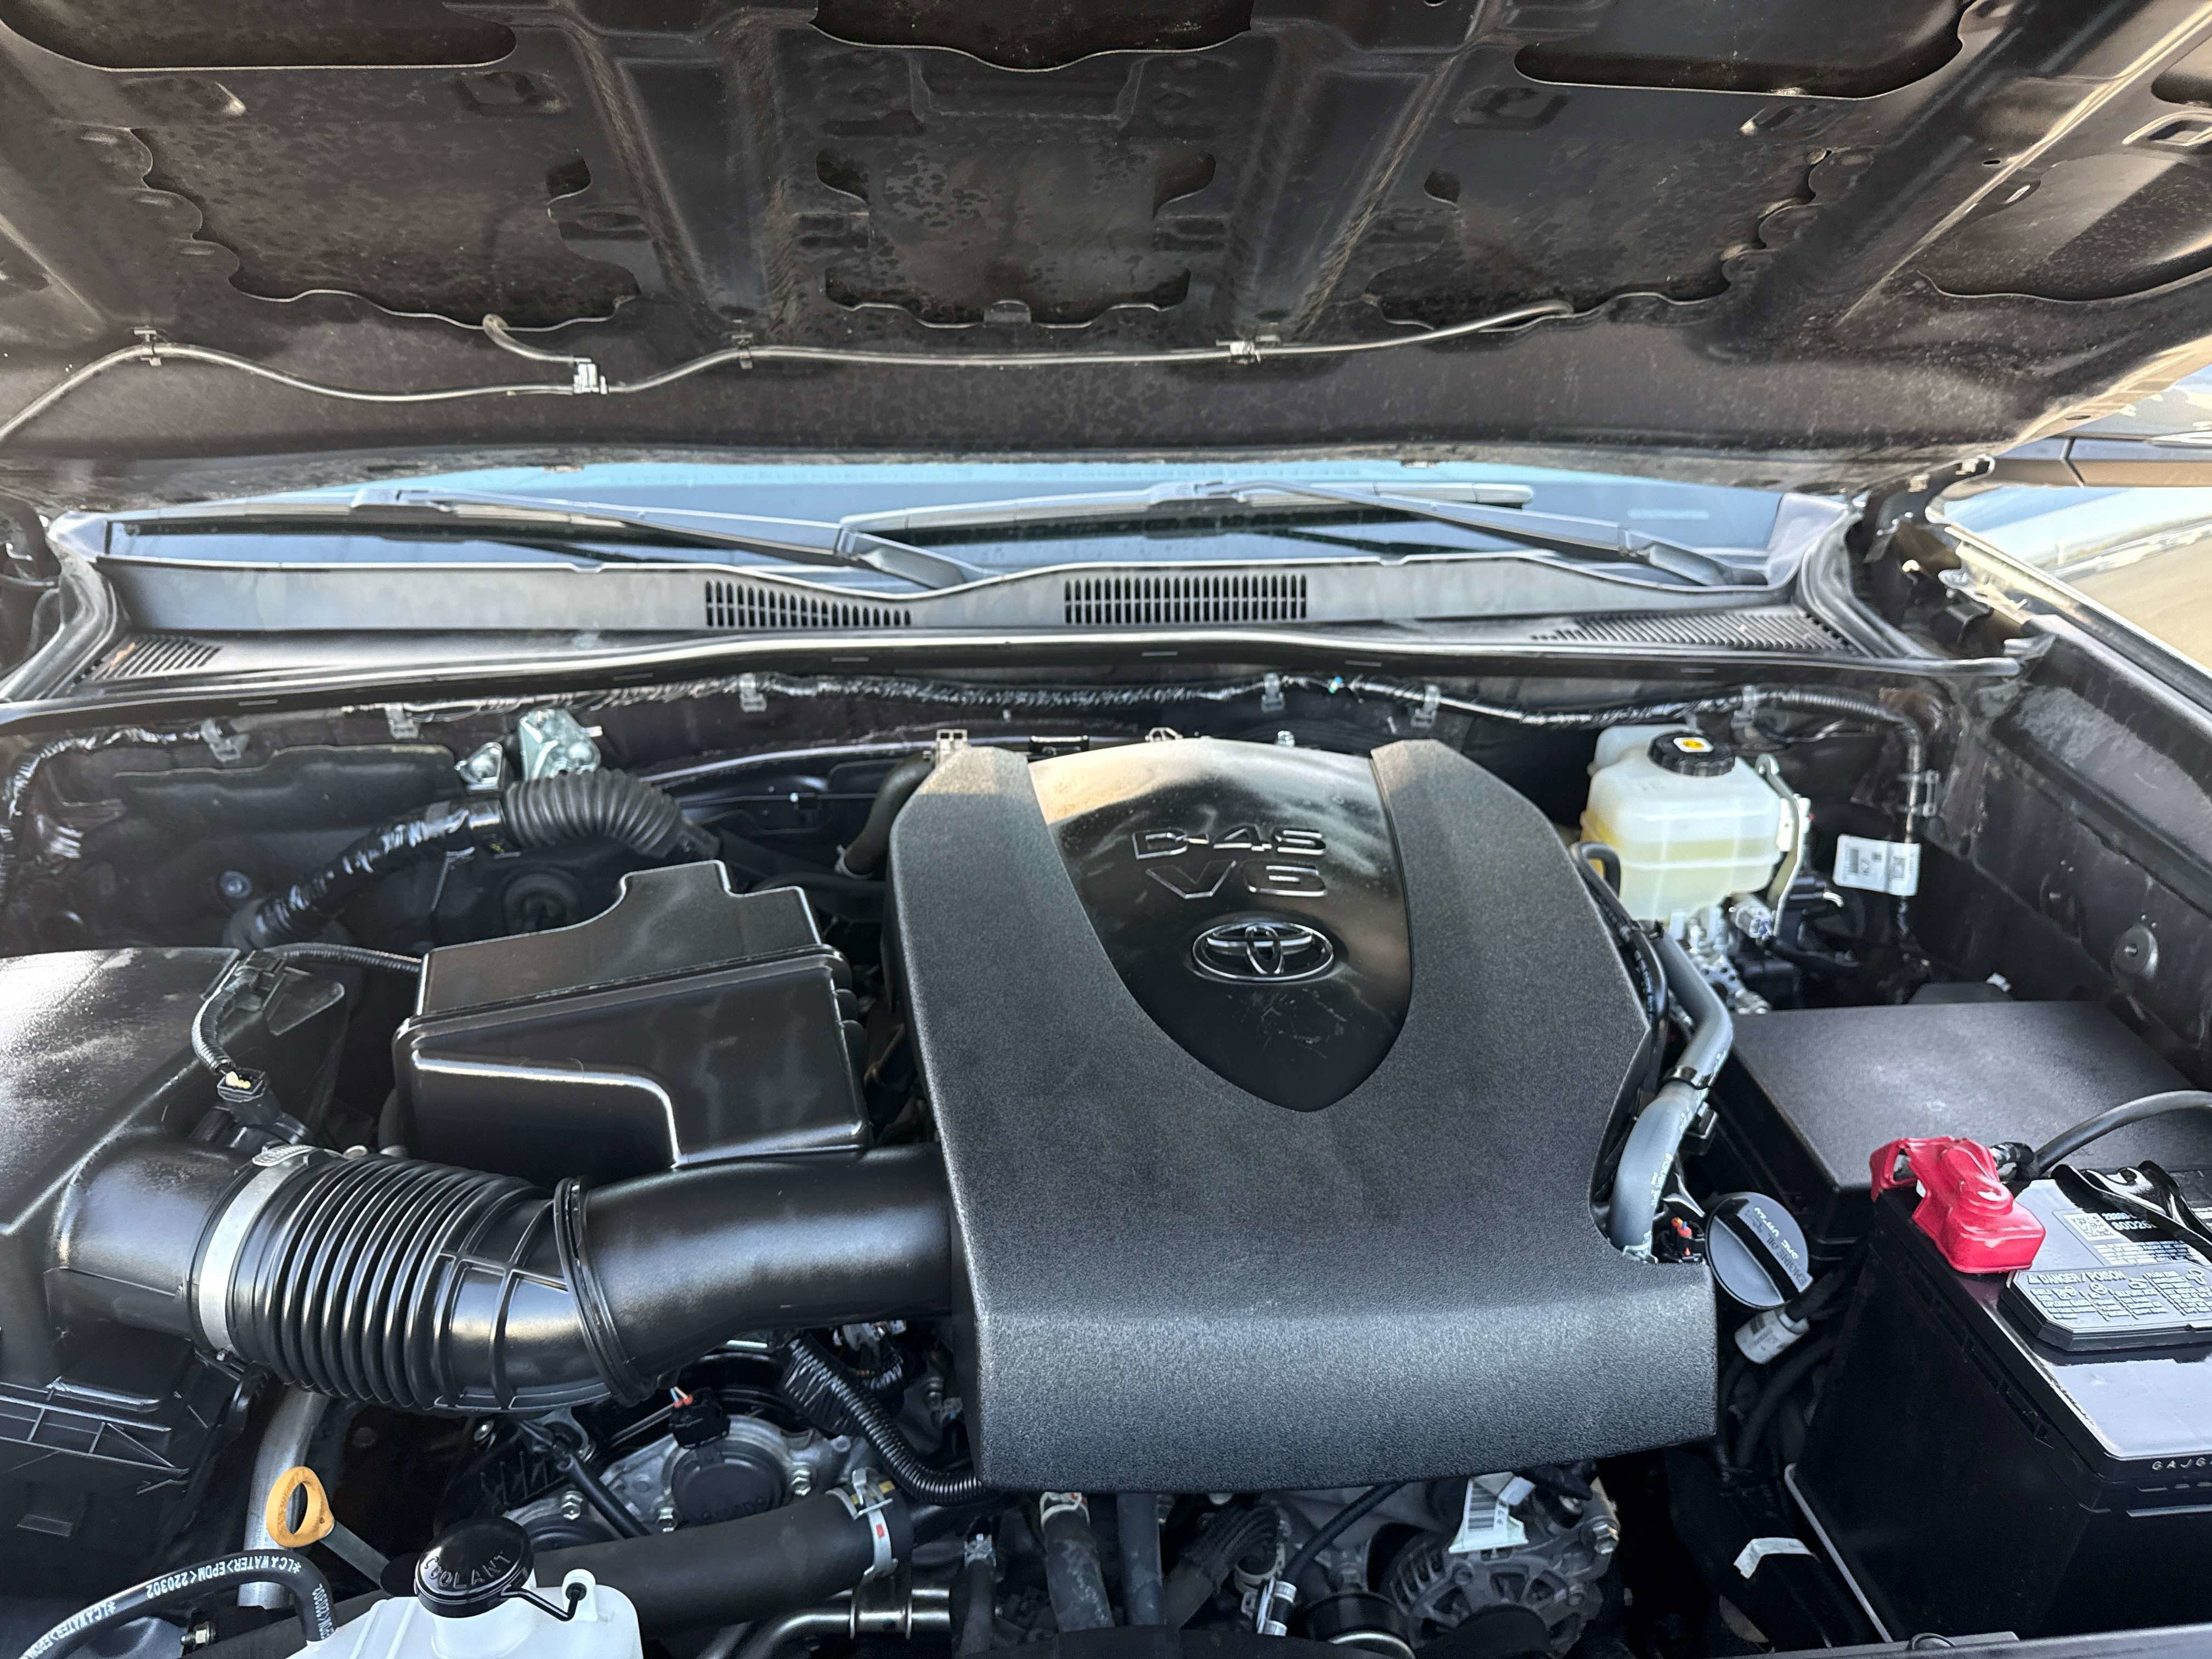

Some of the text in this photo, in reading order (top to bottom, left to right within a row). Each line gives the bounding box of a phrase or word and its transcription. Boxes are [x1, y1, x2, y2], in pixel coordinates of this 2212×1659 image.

[2038, 1273, 2081, 1284] DANGER
[2085, 1271, 2128, 1282] POISON
[424, 1551, 511, 1589] COOLANT
